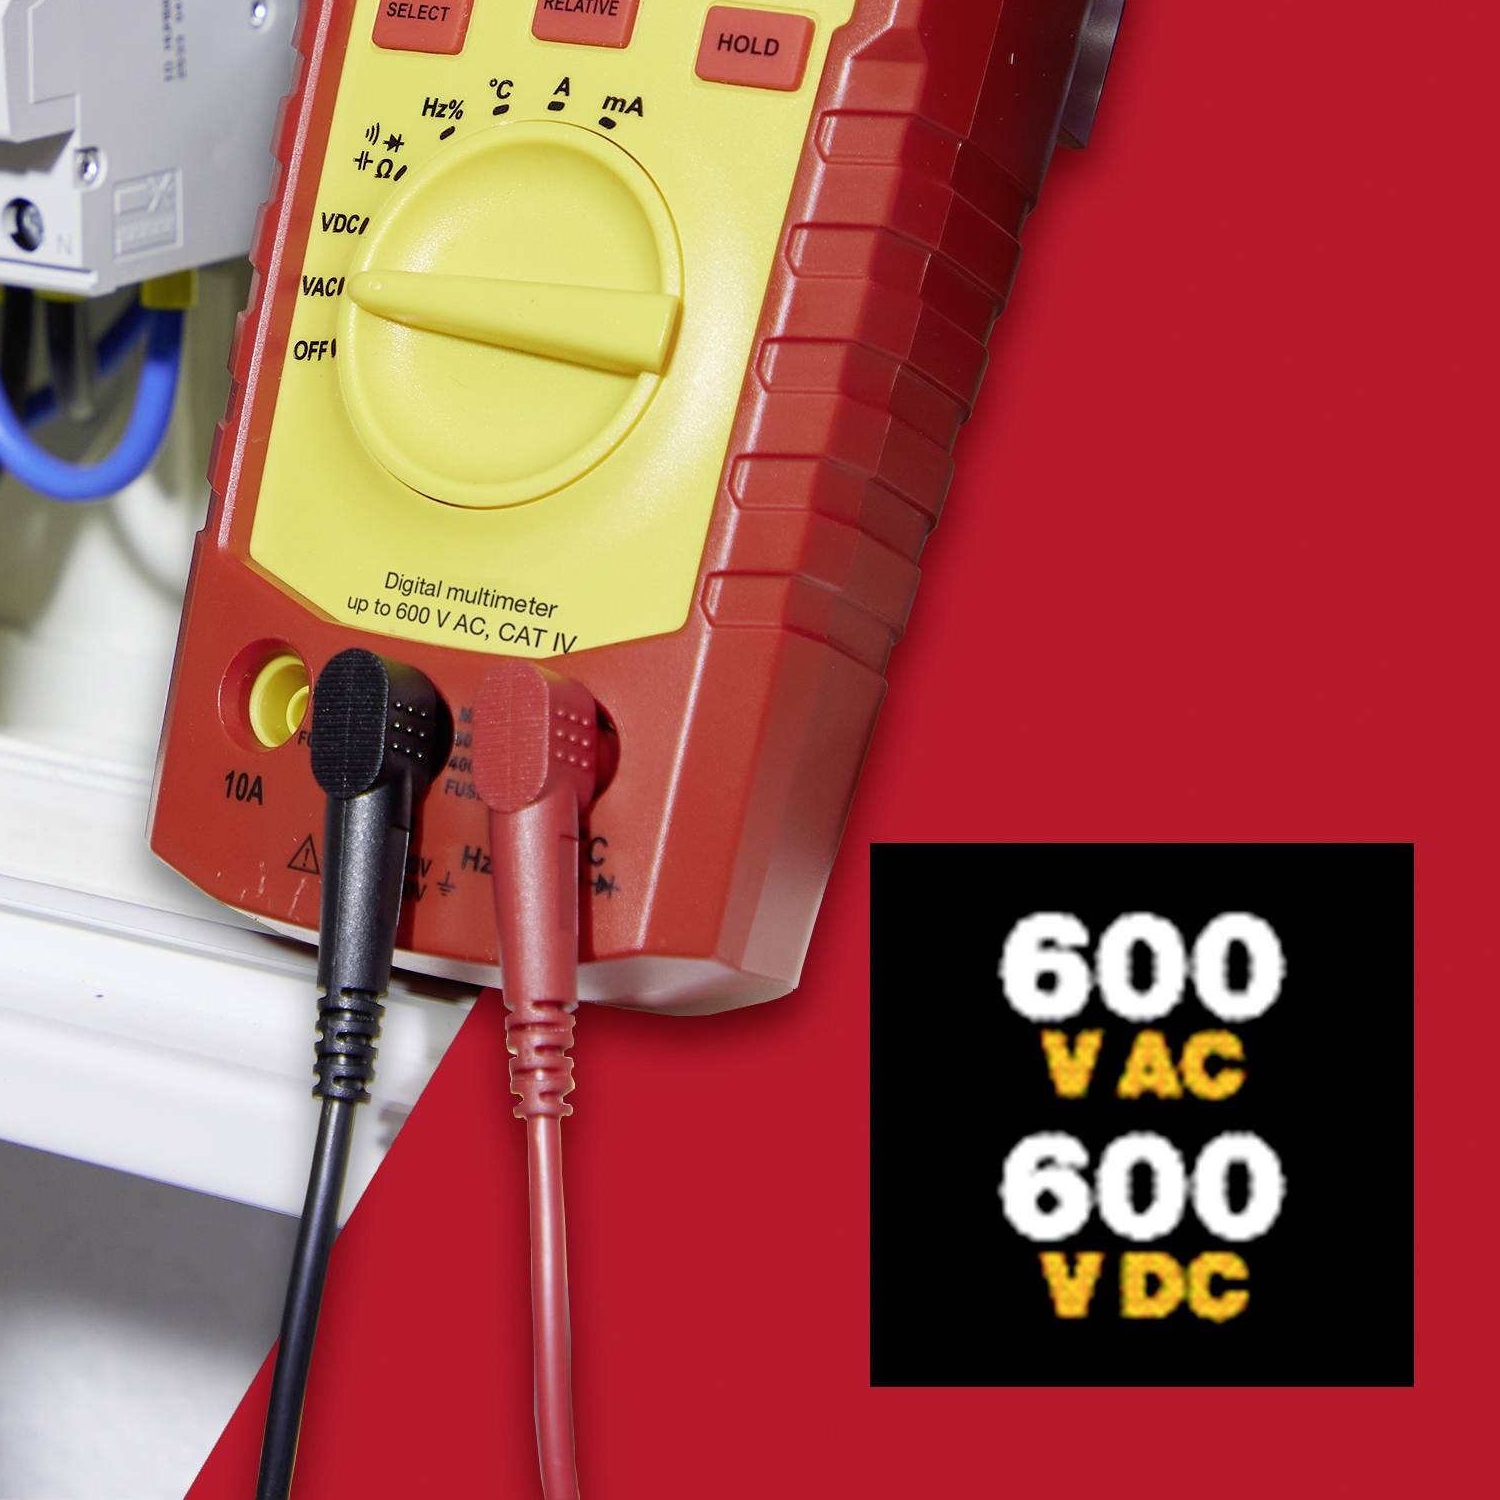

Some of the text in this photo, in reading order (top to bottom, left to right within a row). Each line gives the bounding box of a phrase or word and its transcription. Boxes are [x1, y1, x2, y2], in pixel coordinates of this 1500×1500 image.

[386, 1, 451, 23] SELECT
[717, 32, 780, 58] HOLD
[553, 76, 572, 97] A
[422, 97, 465, 121] Hz%
[602, 95, 645, 117] mA
[321, 212, 361, 234] VDC
[302, 275, 338, 297] VAC
[293, 340, 329, 361] OFF
[384, 571, 558, 620] Digital multimeter
[347, 595, 578, 655] up to 600 V AC, CAT IV
[224, 769, 265, 805] 10A
[445, 779, 481, 801] FUS
